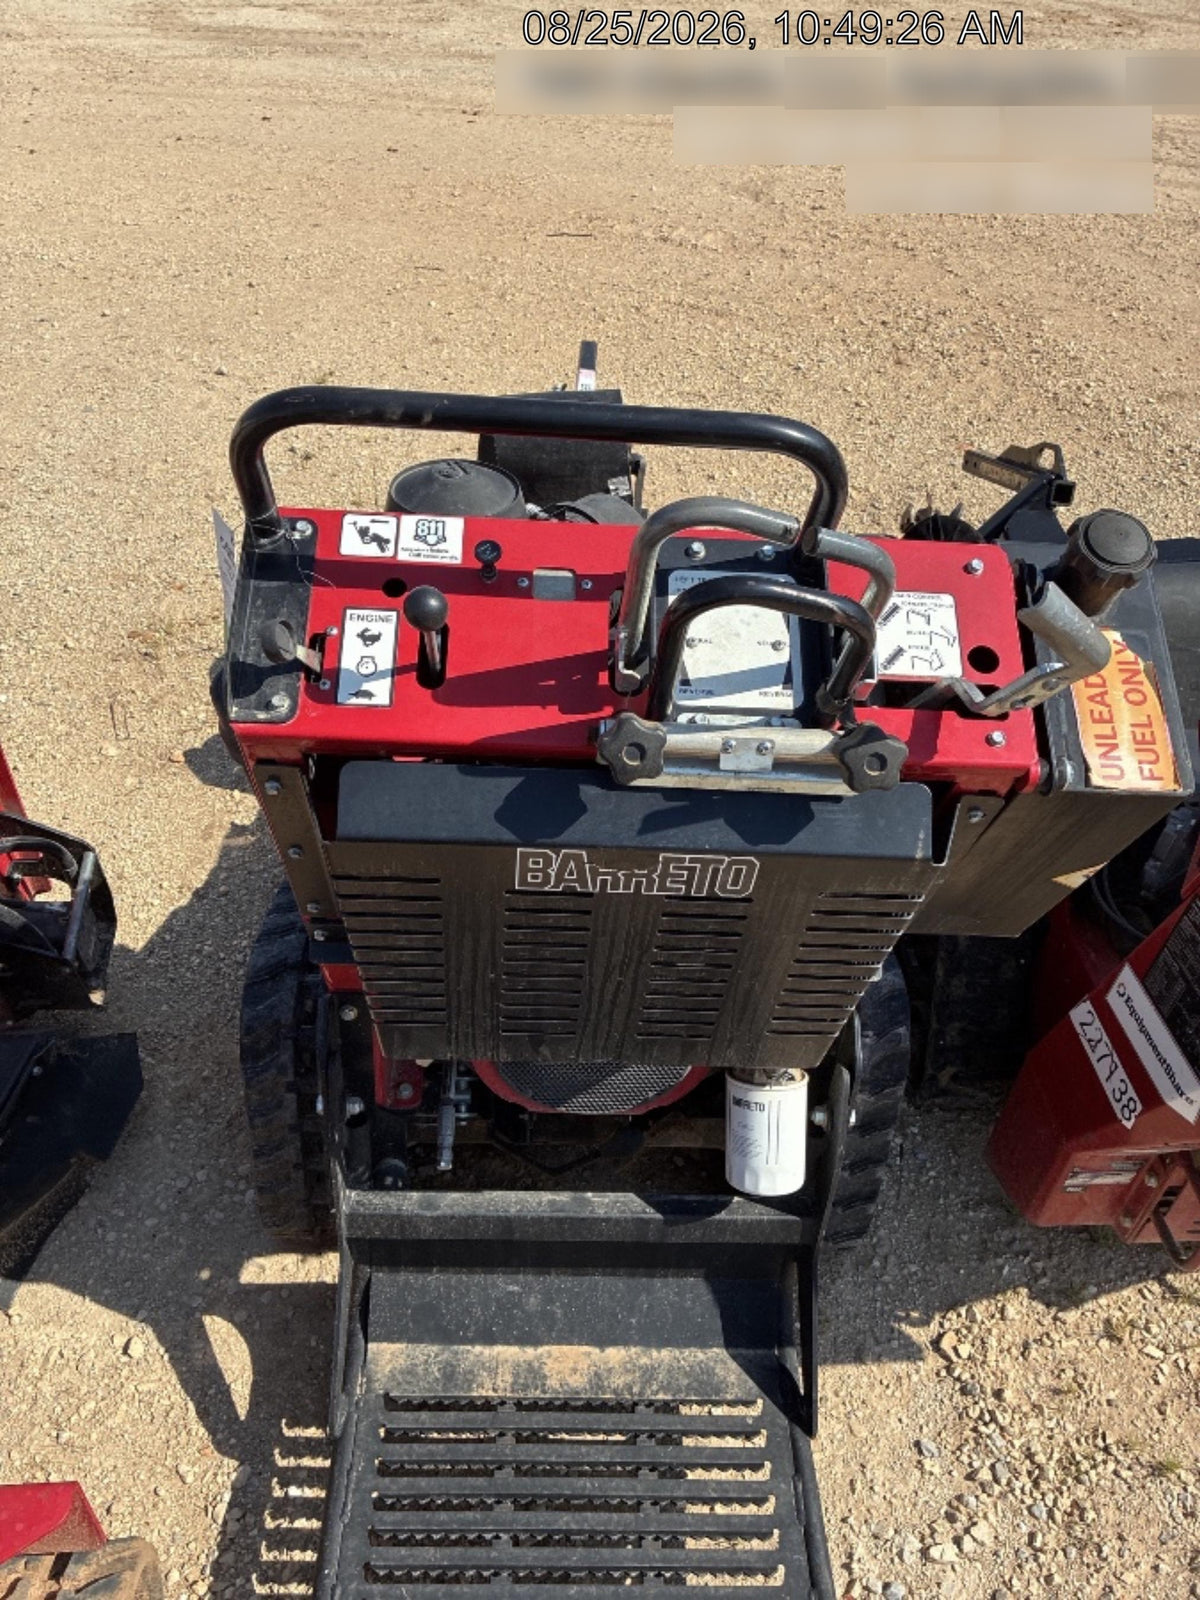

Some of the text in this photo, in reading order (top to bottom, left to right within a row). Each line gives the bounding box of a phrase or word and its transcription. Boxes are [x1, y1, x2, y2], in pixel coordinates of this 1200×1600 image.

[416, 519, 446, 537] 811
[349, 612, 393, 624] ENGINE
[1083, 671, 1126, 781] UNLEAD
[1129, 714, 1164, 781] FUEL
